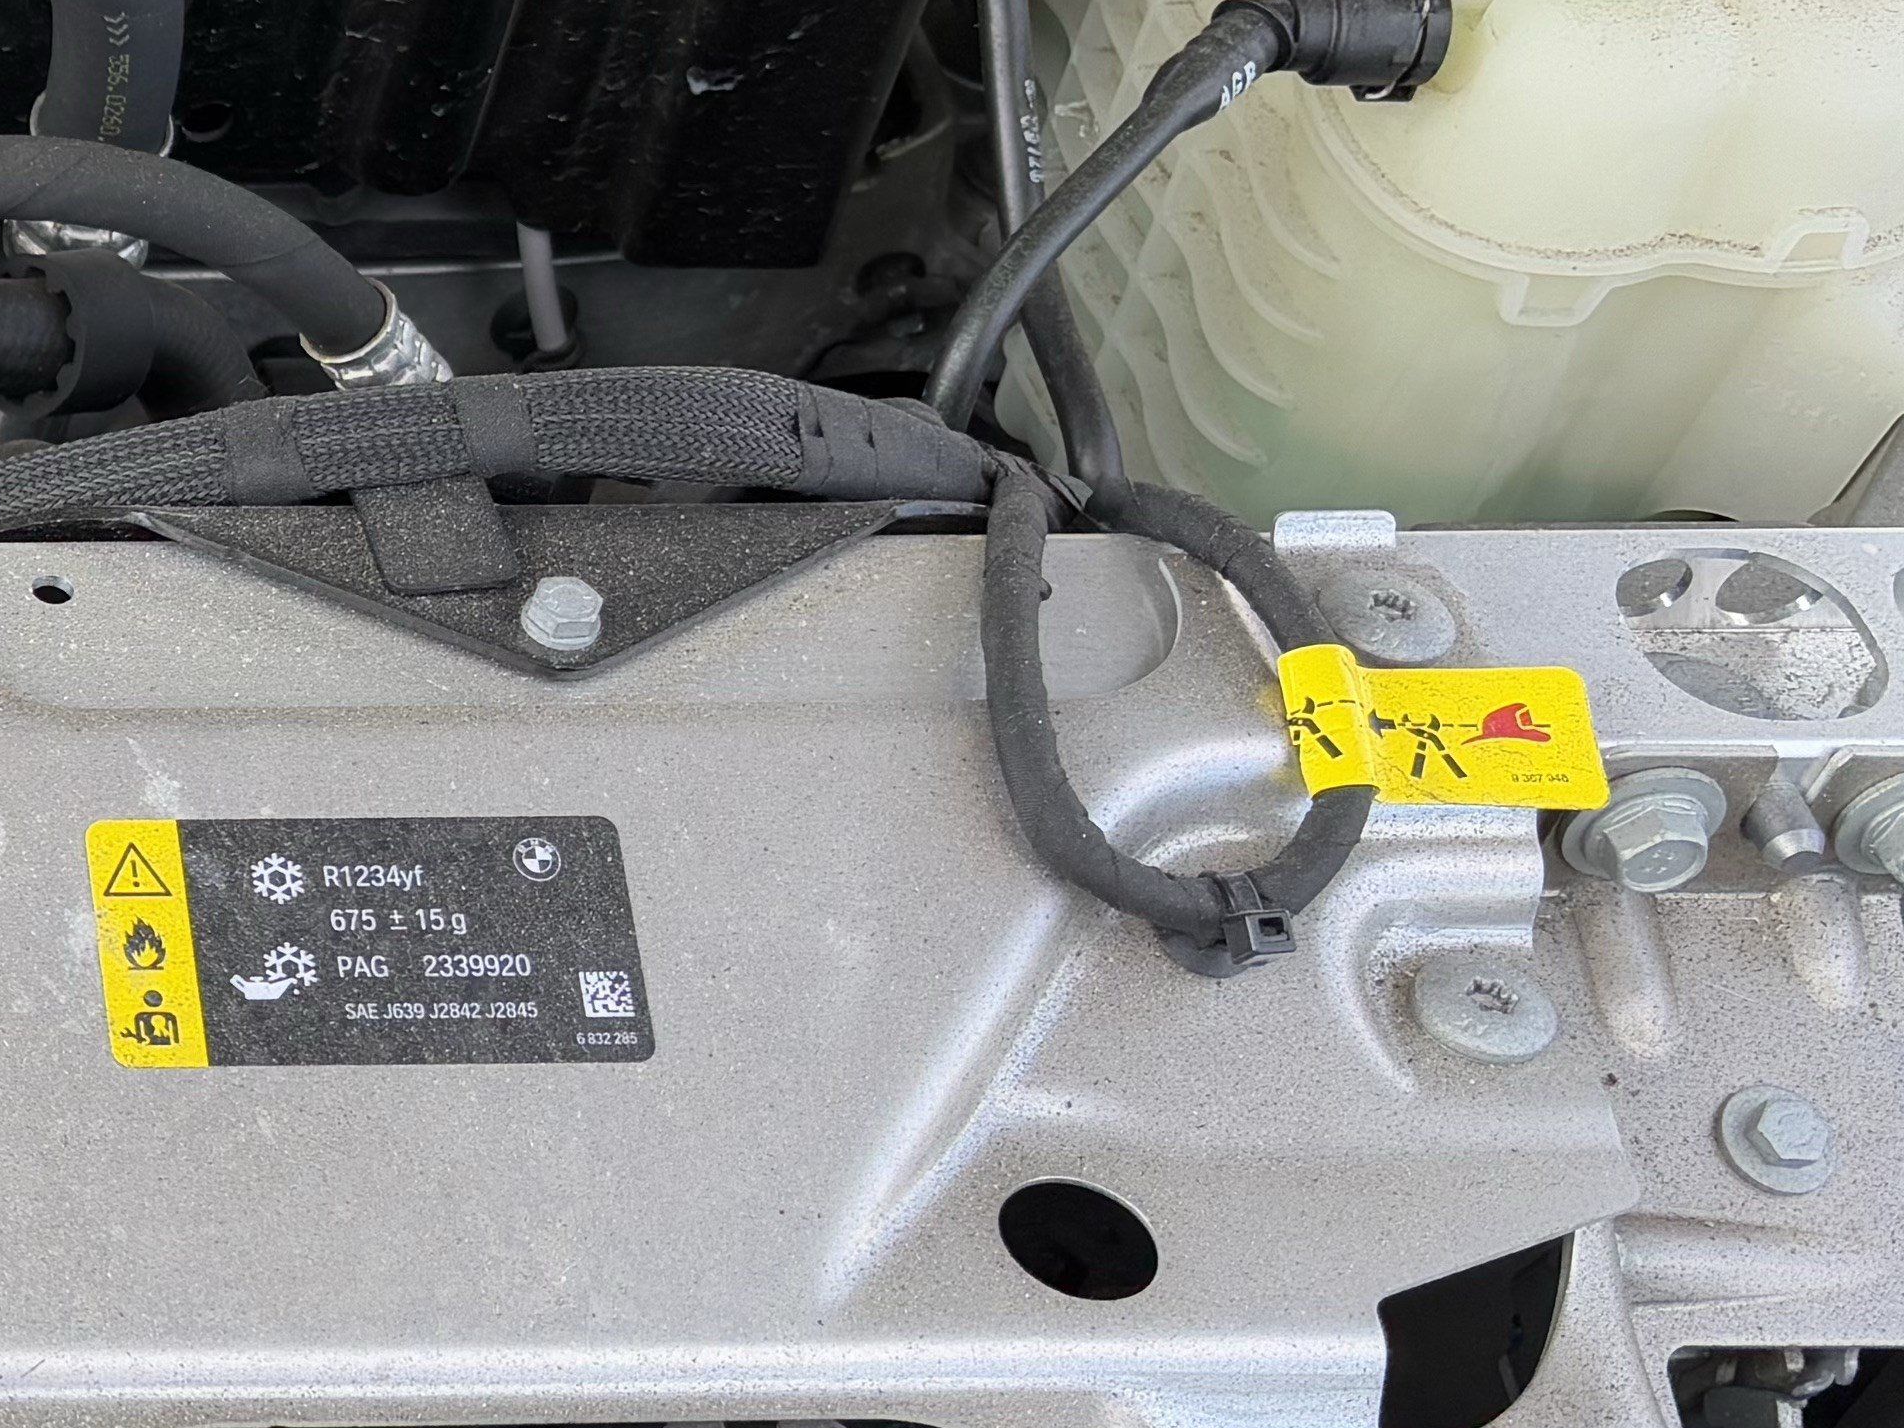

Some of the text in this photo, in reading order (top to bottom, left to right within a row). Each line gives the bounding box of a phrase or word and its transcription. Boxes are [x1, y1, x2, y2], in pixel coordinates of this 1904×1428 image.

[323, 863, 424, 893] R1234yf
[330, 909, 376, 932] 675
[414, 908, 445, 931] 15
[448, 913, 467, 935] g
[337, 954, 531, 978] PAG 2339920
[345, 1001, 538, 1021] SAE J639 J2842 J2845
[576, 1031, 638, 1045] 6 832 285
